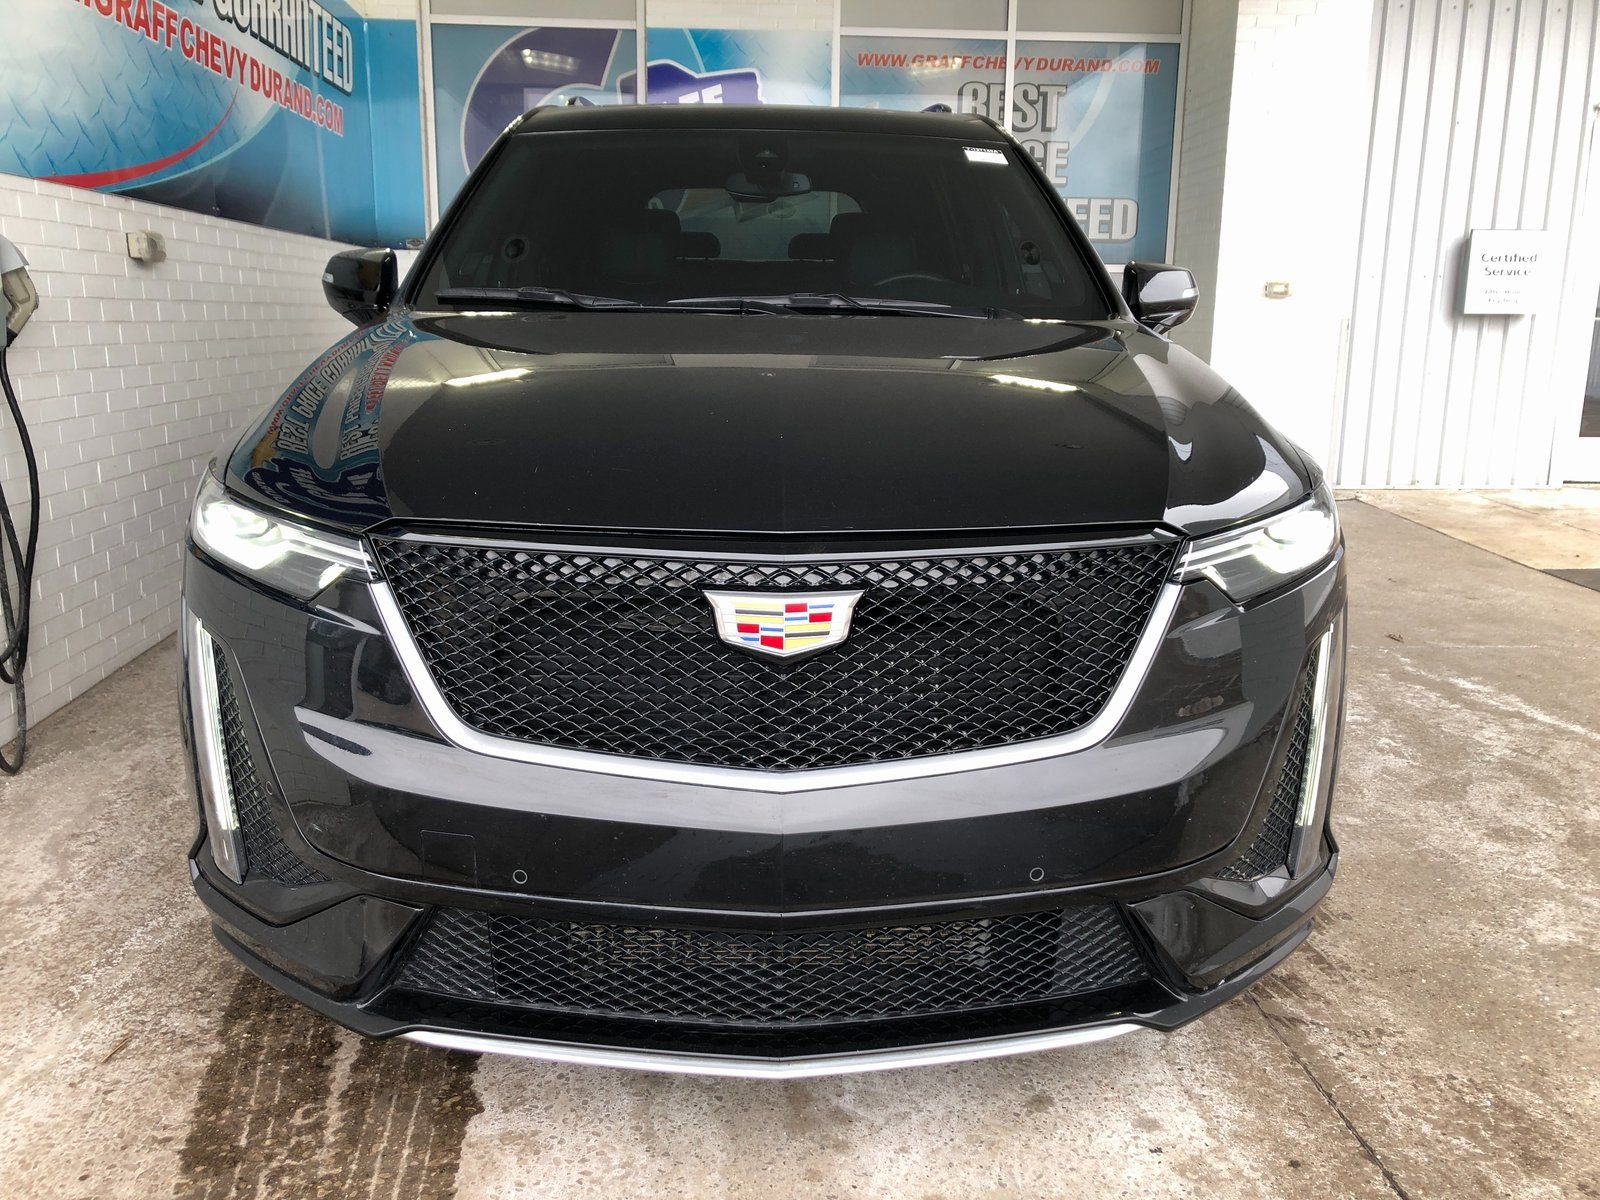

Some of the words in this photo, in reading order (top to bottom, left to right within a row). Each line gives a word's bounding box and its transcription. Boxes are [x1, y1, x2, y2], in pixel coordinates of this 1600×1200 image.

[958, 81, 1068, 133] BEST
[1481, 253, 1538, 263] Certified
[1484, 266, 1531, 276] Service
